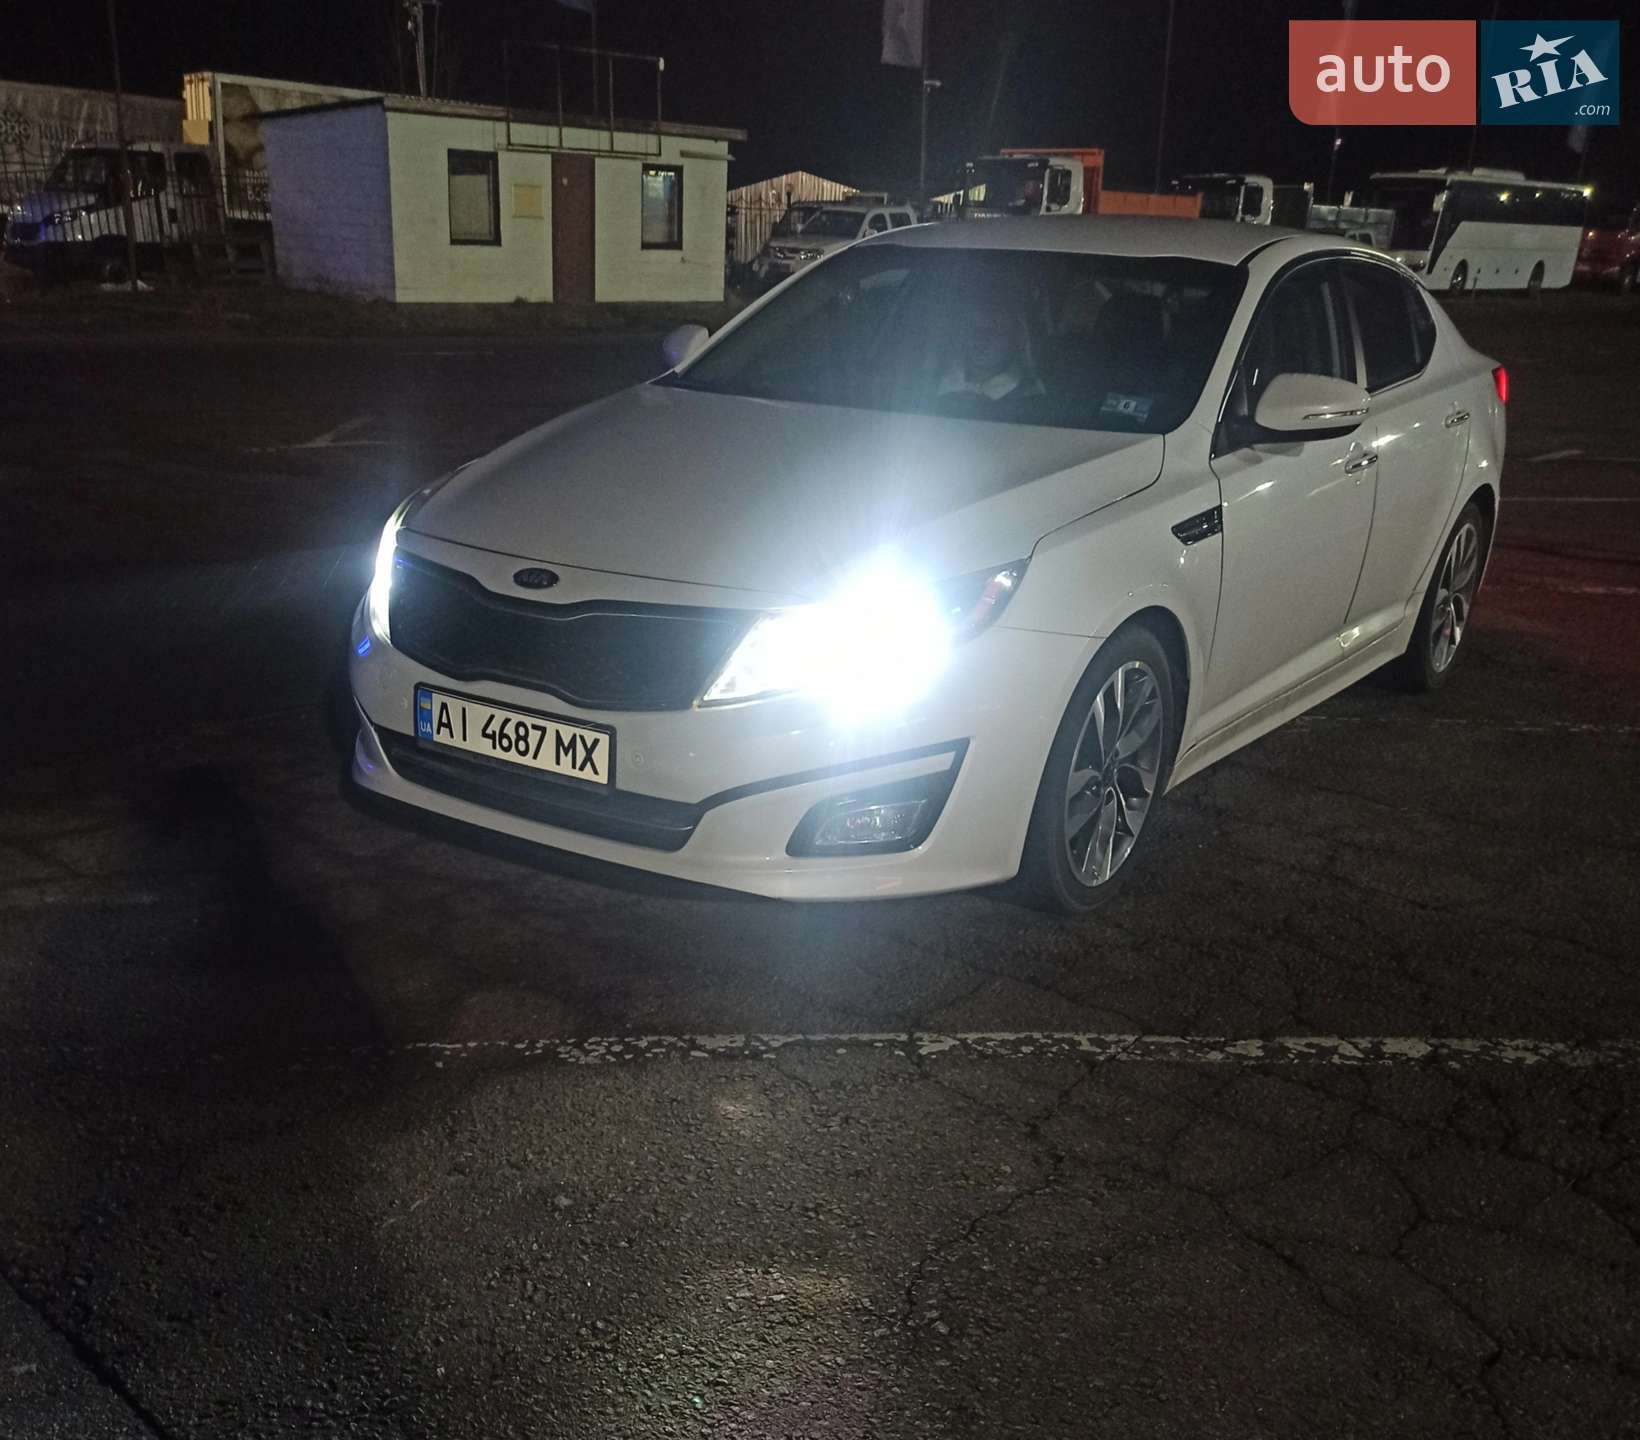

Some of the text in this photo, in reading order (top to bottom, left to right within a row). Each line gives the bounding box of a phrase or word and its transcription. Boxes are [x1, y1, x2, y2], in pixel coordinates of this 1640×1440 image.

[420, 721, 432, 734] UA
[436, 701, 467, 742] AI
[481, 714, 547, 760] 4687
[555, 729, 600, 776] MX
